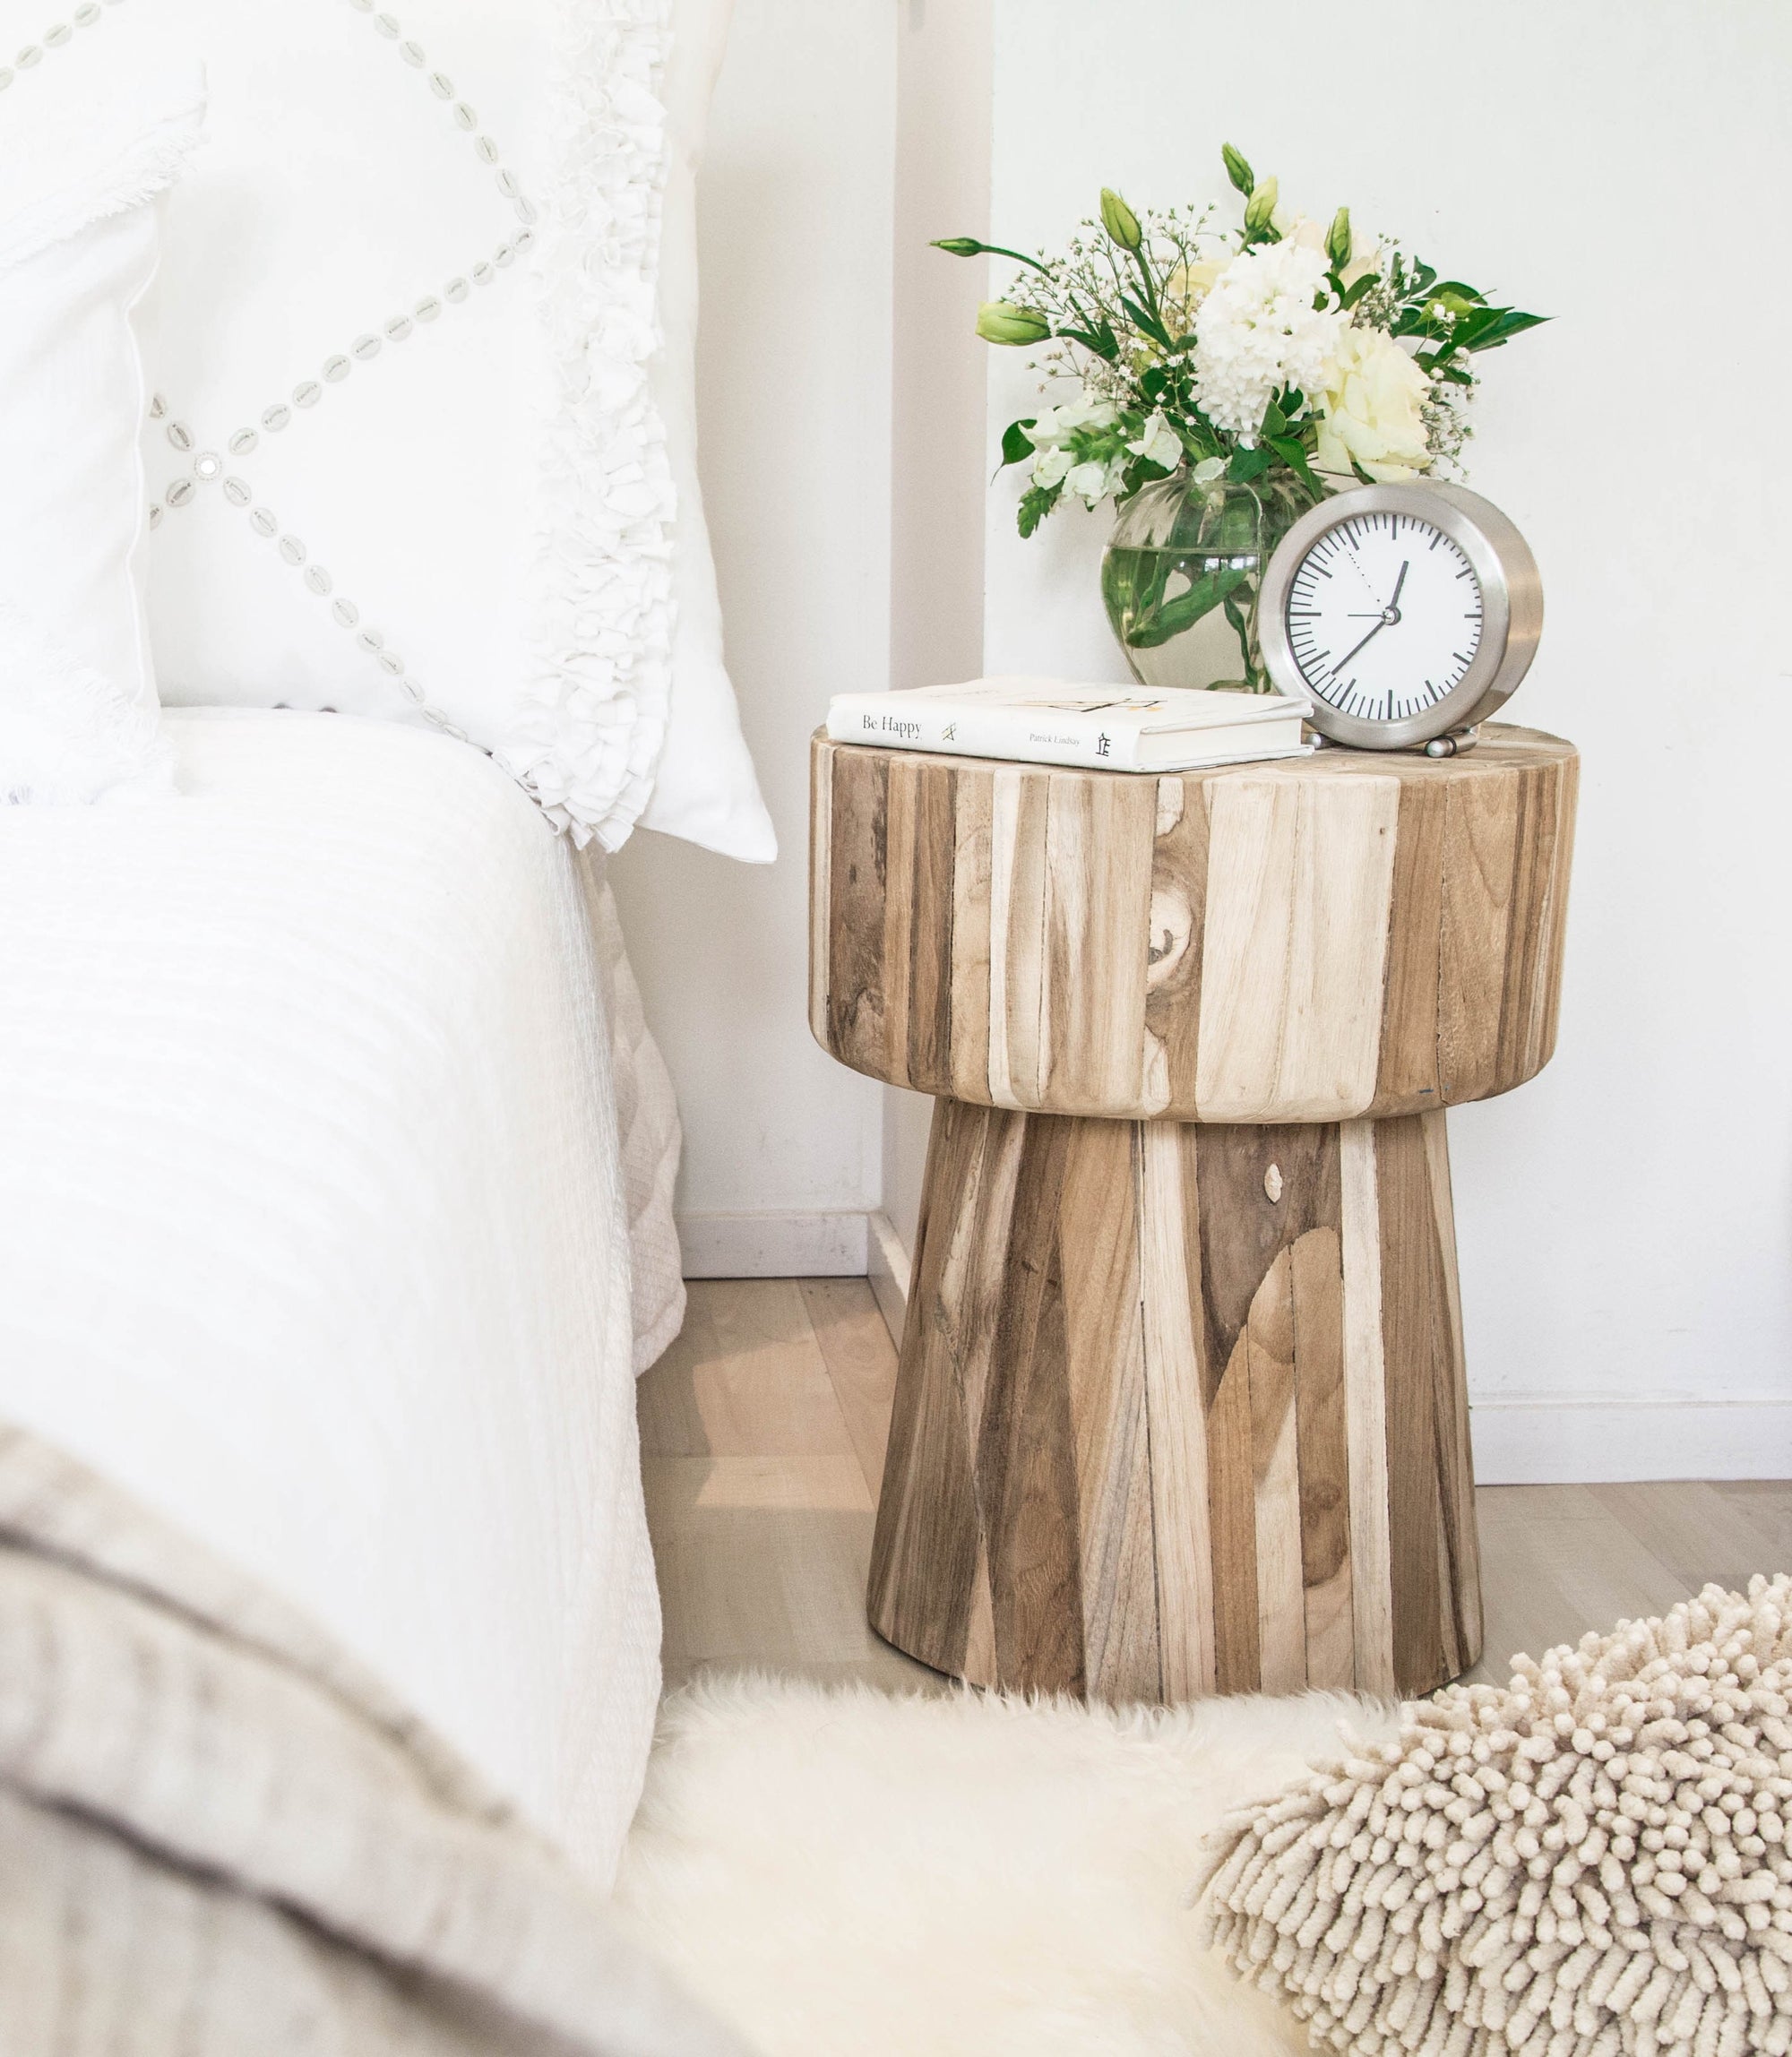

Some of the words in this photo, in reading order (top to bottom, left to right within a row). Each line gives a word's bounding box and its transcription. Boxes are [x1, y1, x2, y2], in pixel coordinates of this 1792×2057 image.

[863, 714, 877, 730] Be
[1030, 733, 1052, 744] Patrick
[1054, 735, 1081, 747] Lindsay
